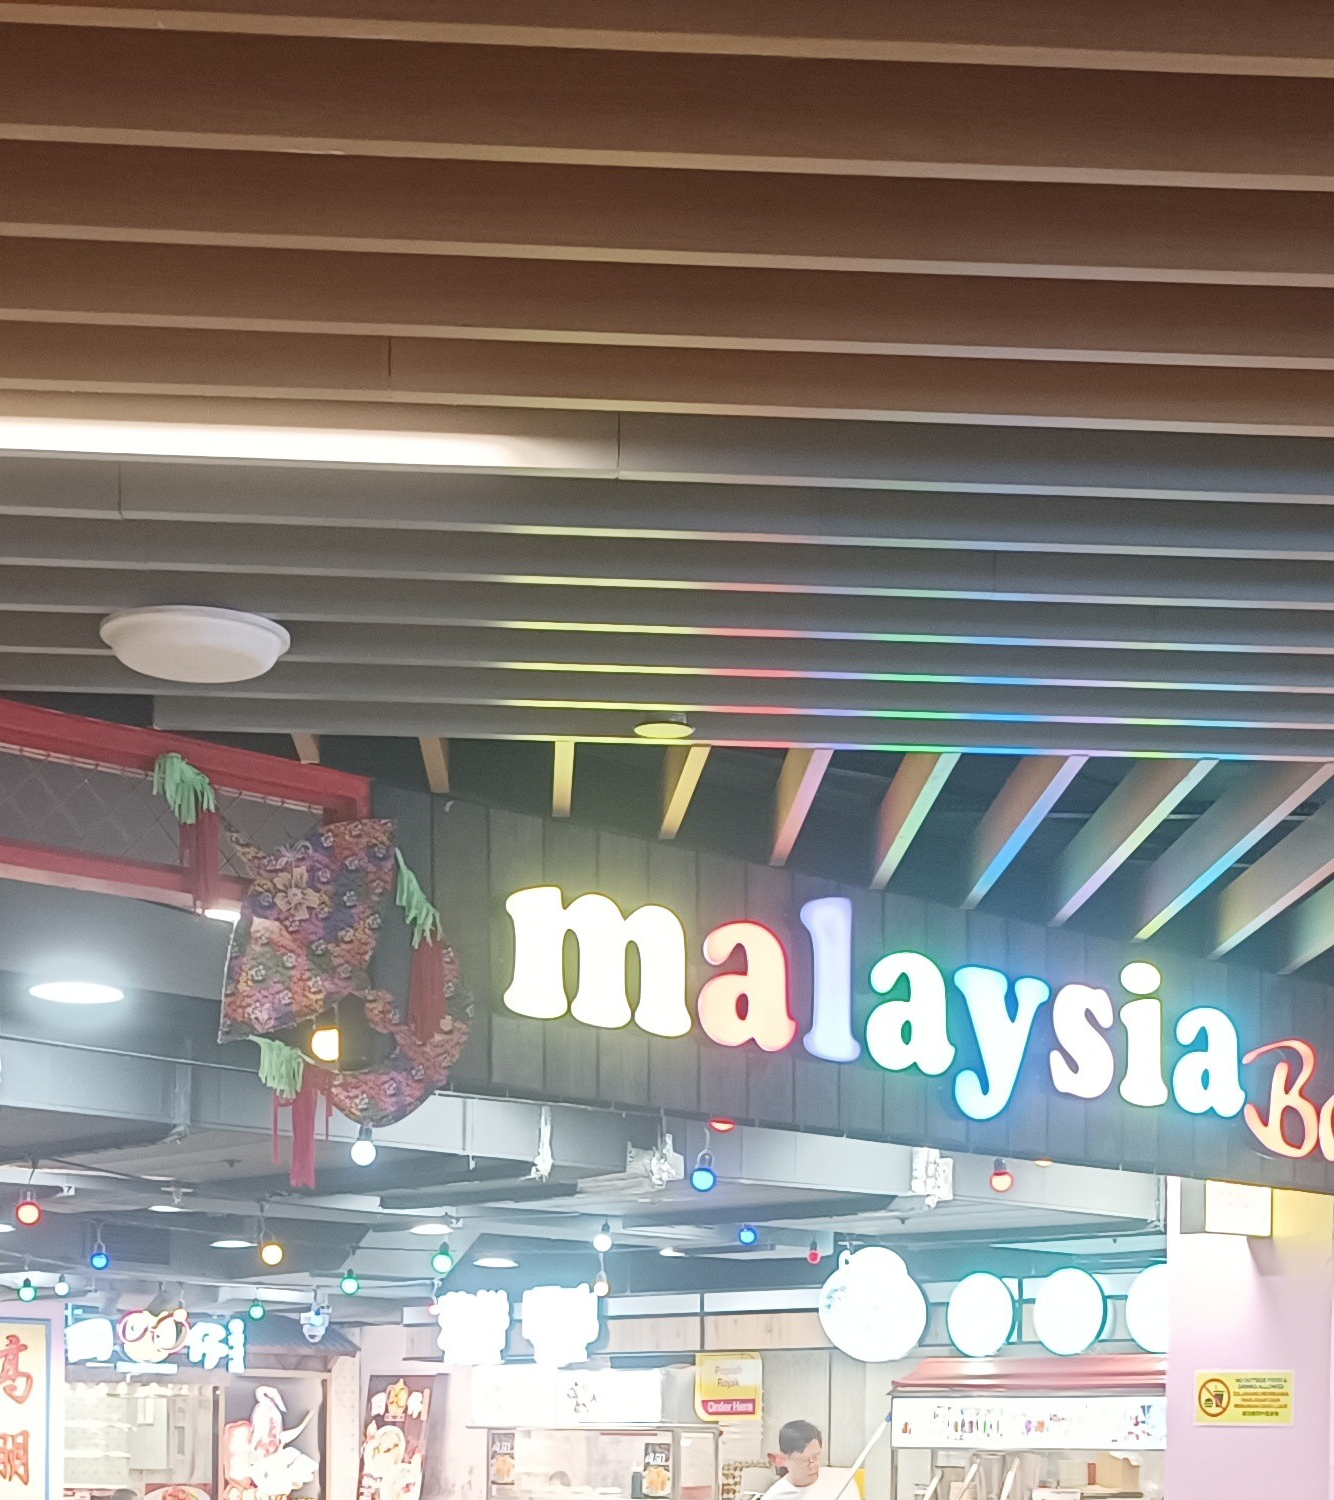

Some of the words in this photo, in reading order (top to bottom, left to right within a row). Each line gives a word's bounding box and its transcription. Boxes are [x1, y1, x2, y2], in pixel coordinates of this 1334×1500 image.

[501, 884, 1246, 1122] malaysia
[717, 1377, 740, 1389] Rojak
[707, 1402, 732, 1413] Order
[732, 1402, 754, 1413] Here
